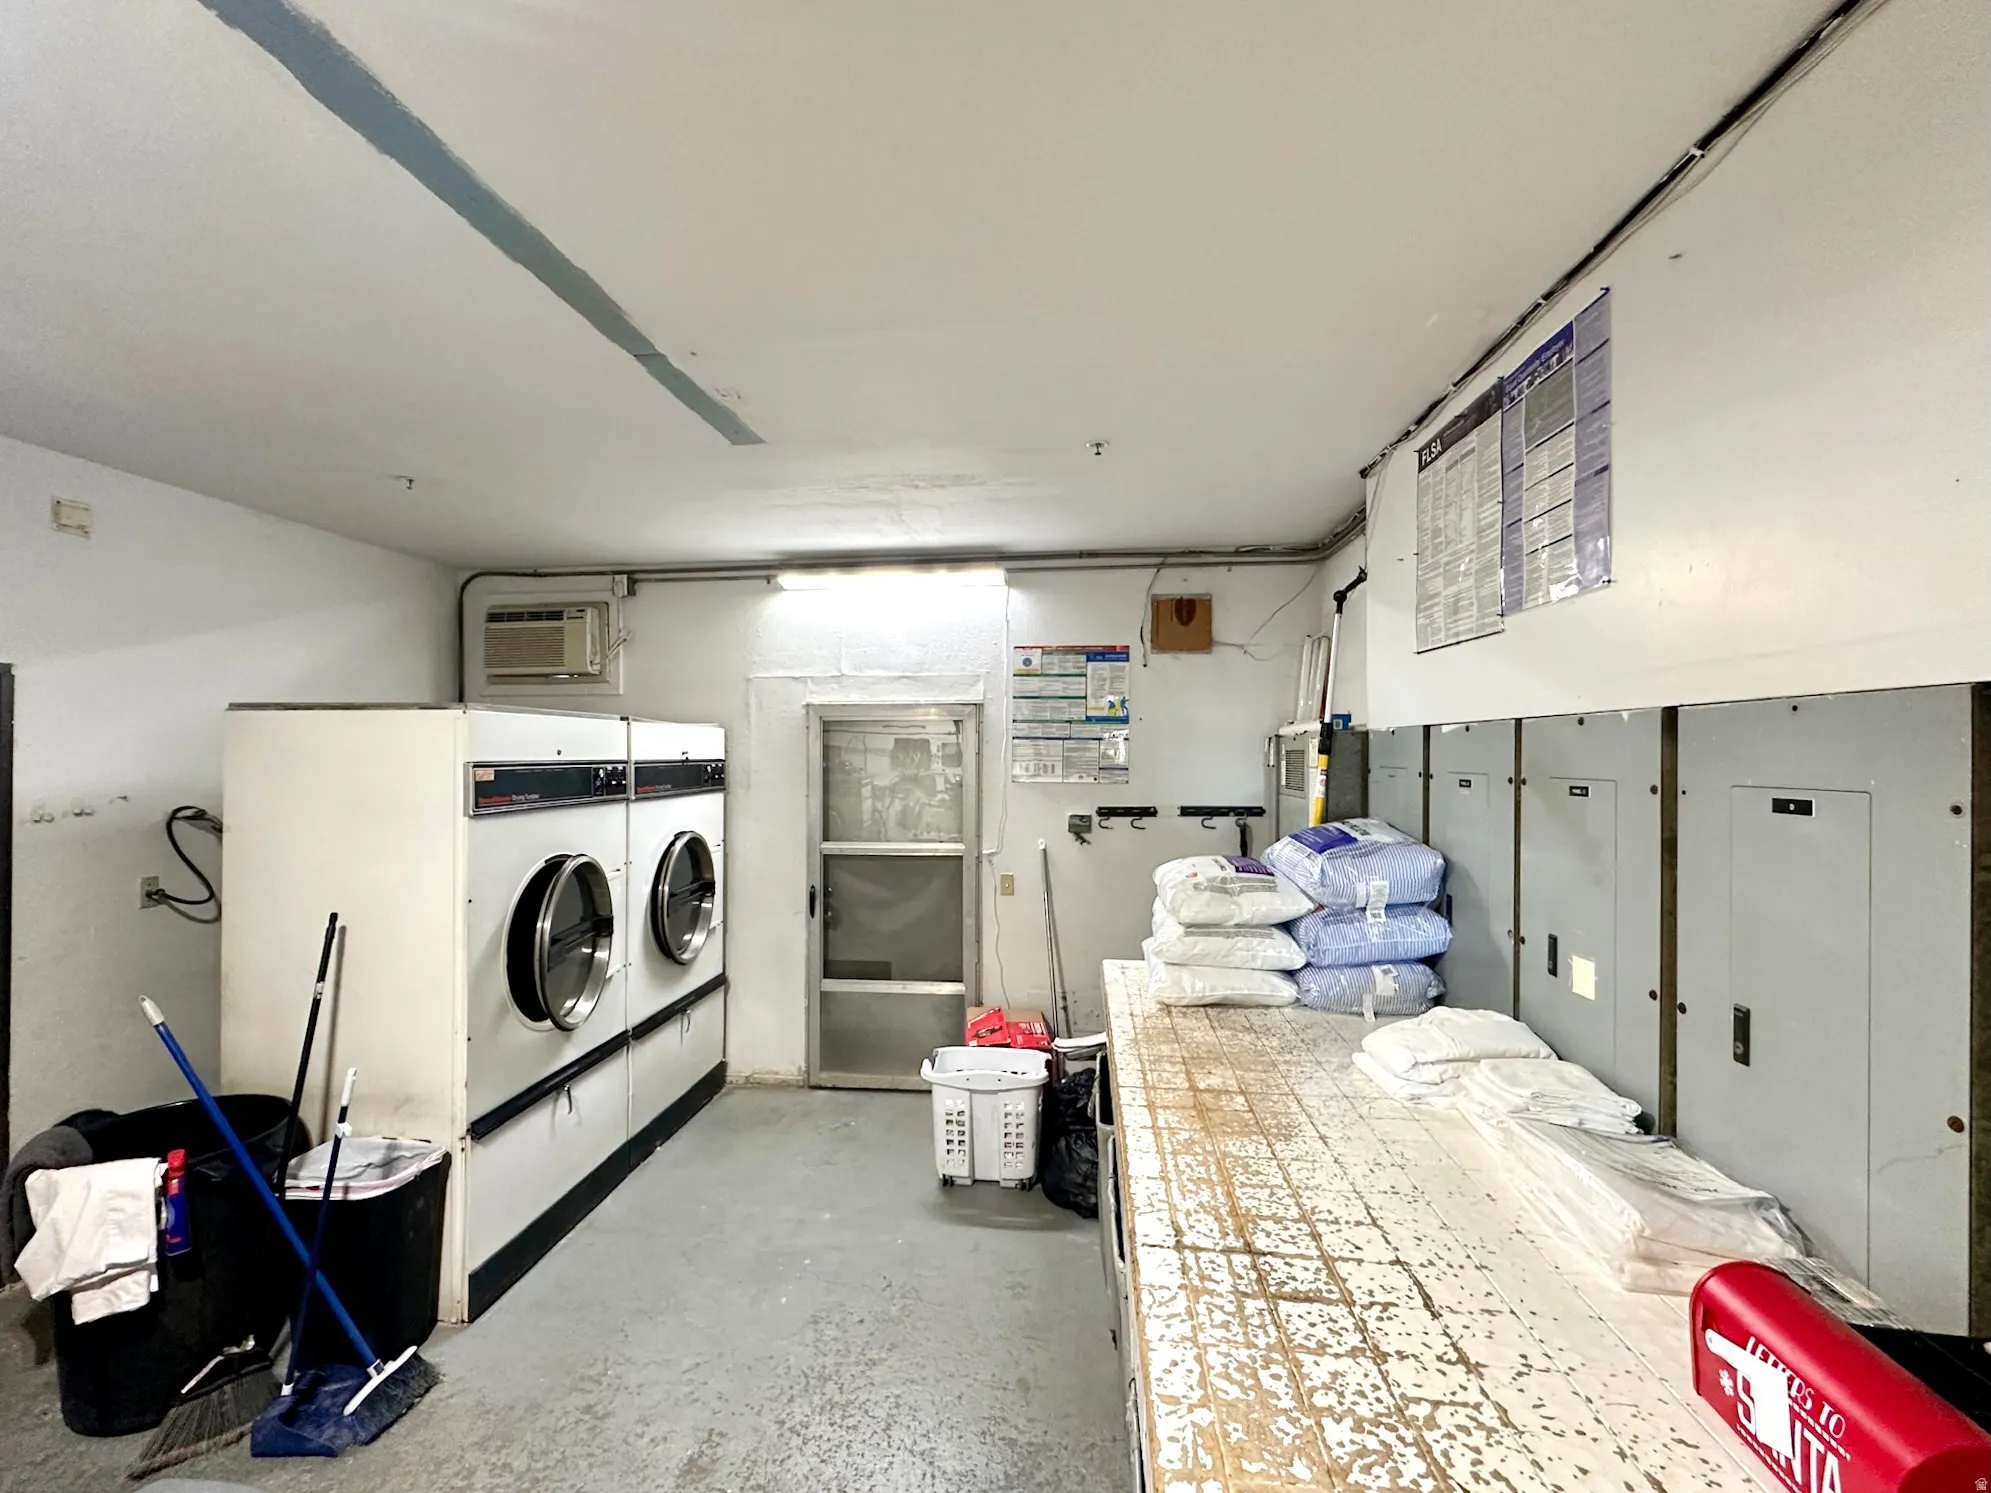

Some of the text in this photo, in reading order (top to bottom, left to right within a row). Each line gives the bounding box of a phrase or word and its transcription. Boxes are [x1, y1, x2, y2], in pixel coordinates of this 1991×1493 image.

[1421, 438, 1443, 466] FLSA
[1736, 1368, 1843, 1493] SNTA
[1818, 1401, 1846, 1439] TO
